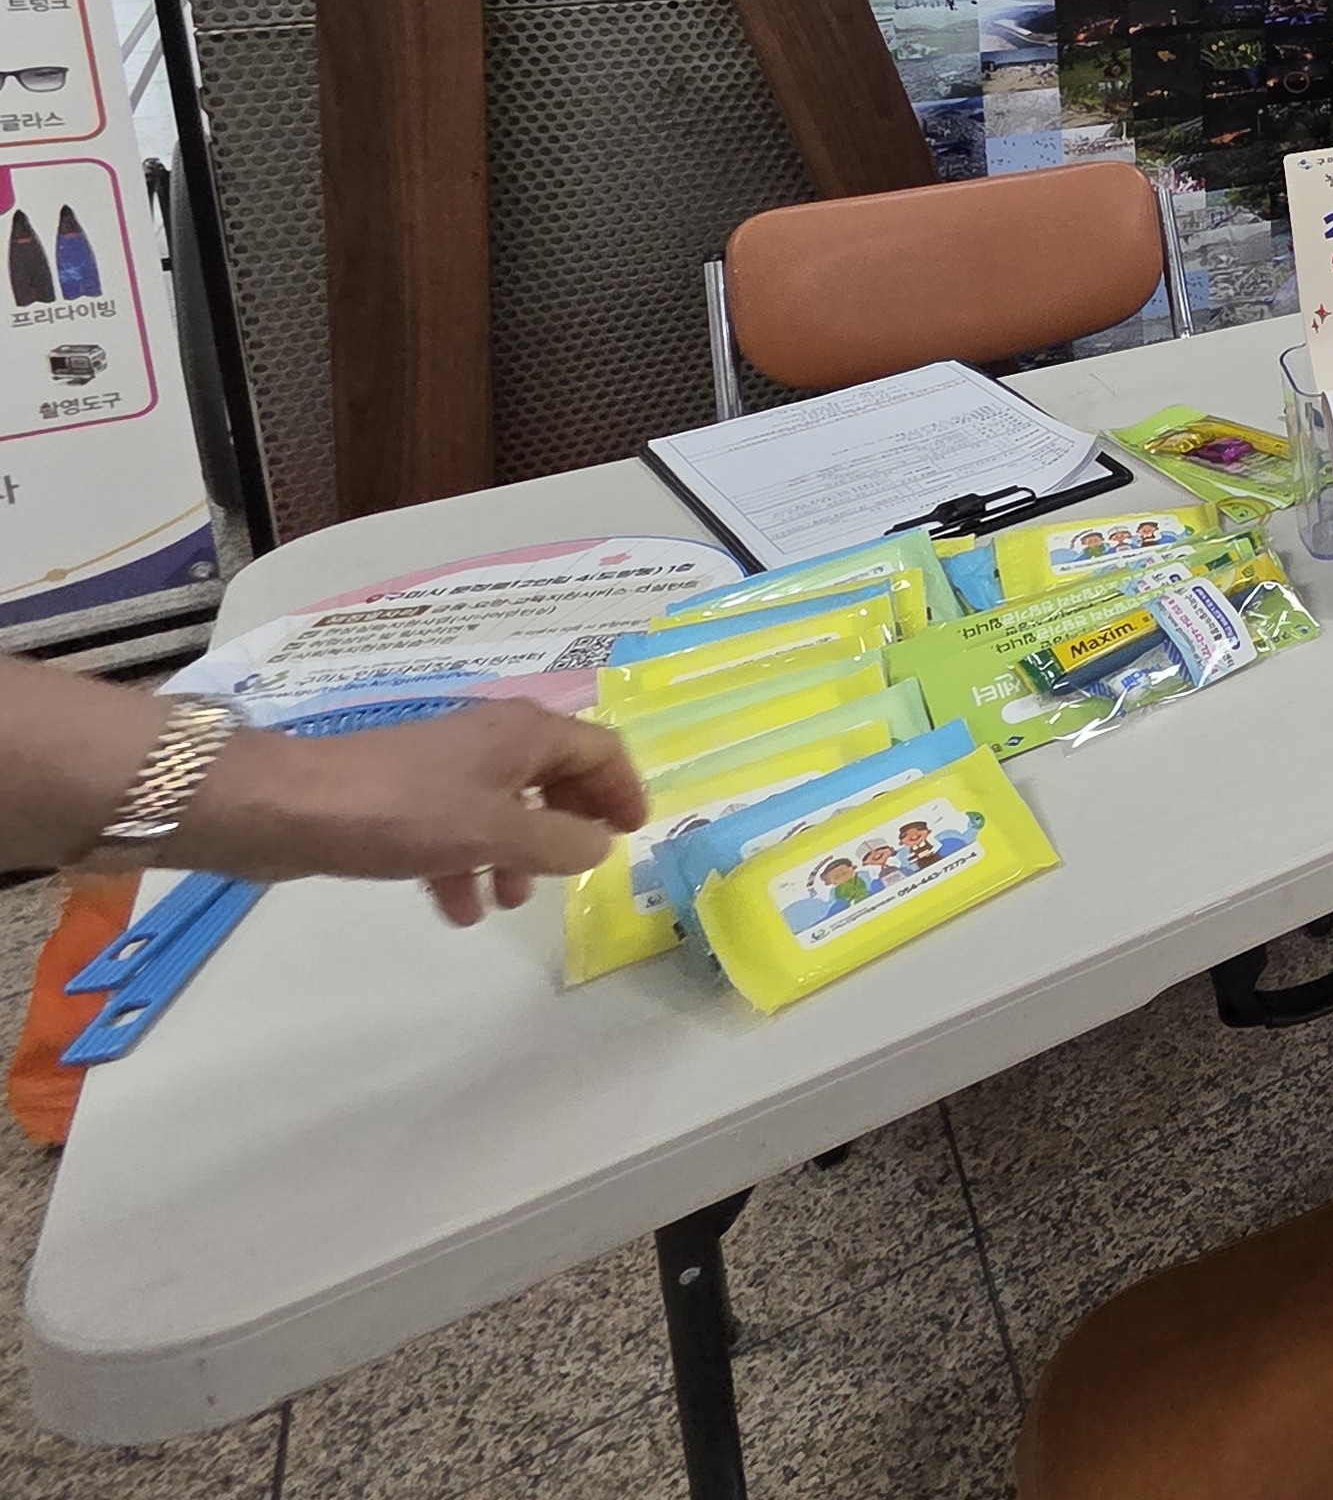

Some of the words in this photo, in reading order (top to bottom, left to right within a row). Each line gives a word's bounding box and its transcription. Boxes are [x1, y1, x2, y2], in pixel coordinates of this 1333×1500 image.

[0, 112, 65, 132] 글라스
[12, 300, 117, 328] 프리다이빙
[39, 392, 122, 420] 촬영도구
[1069, 621, 1135, 660] Maxim
[972, 672, 1021, 707] 센터
